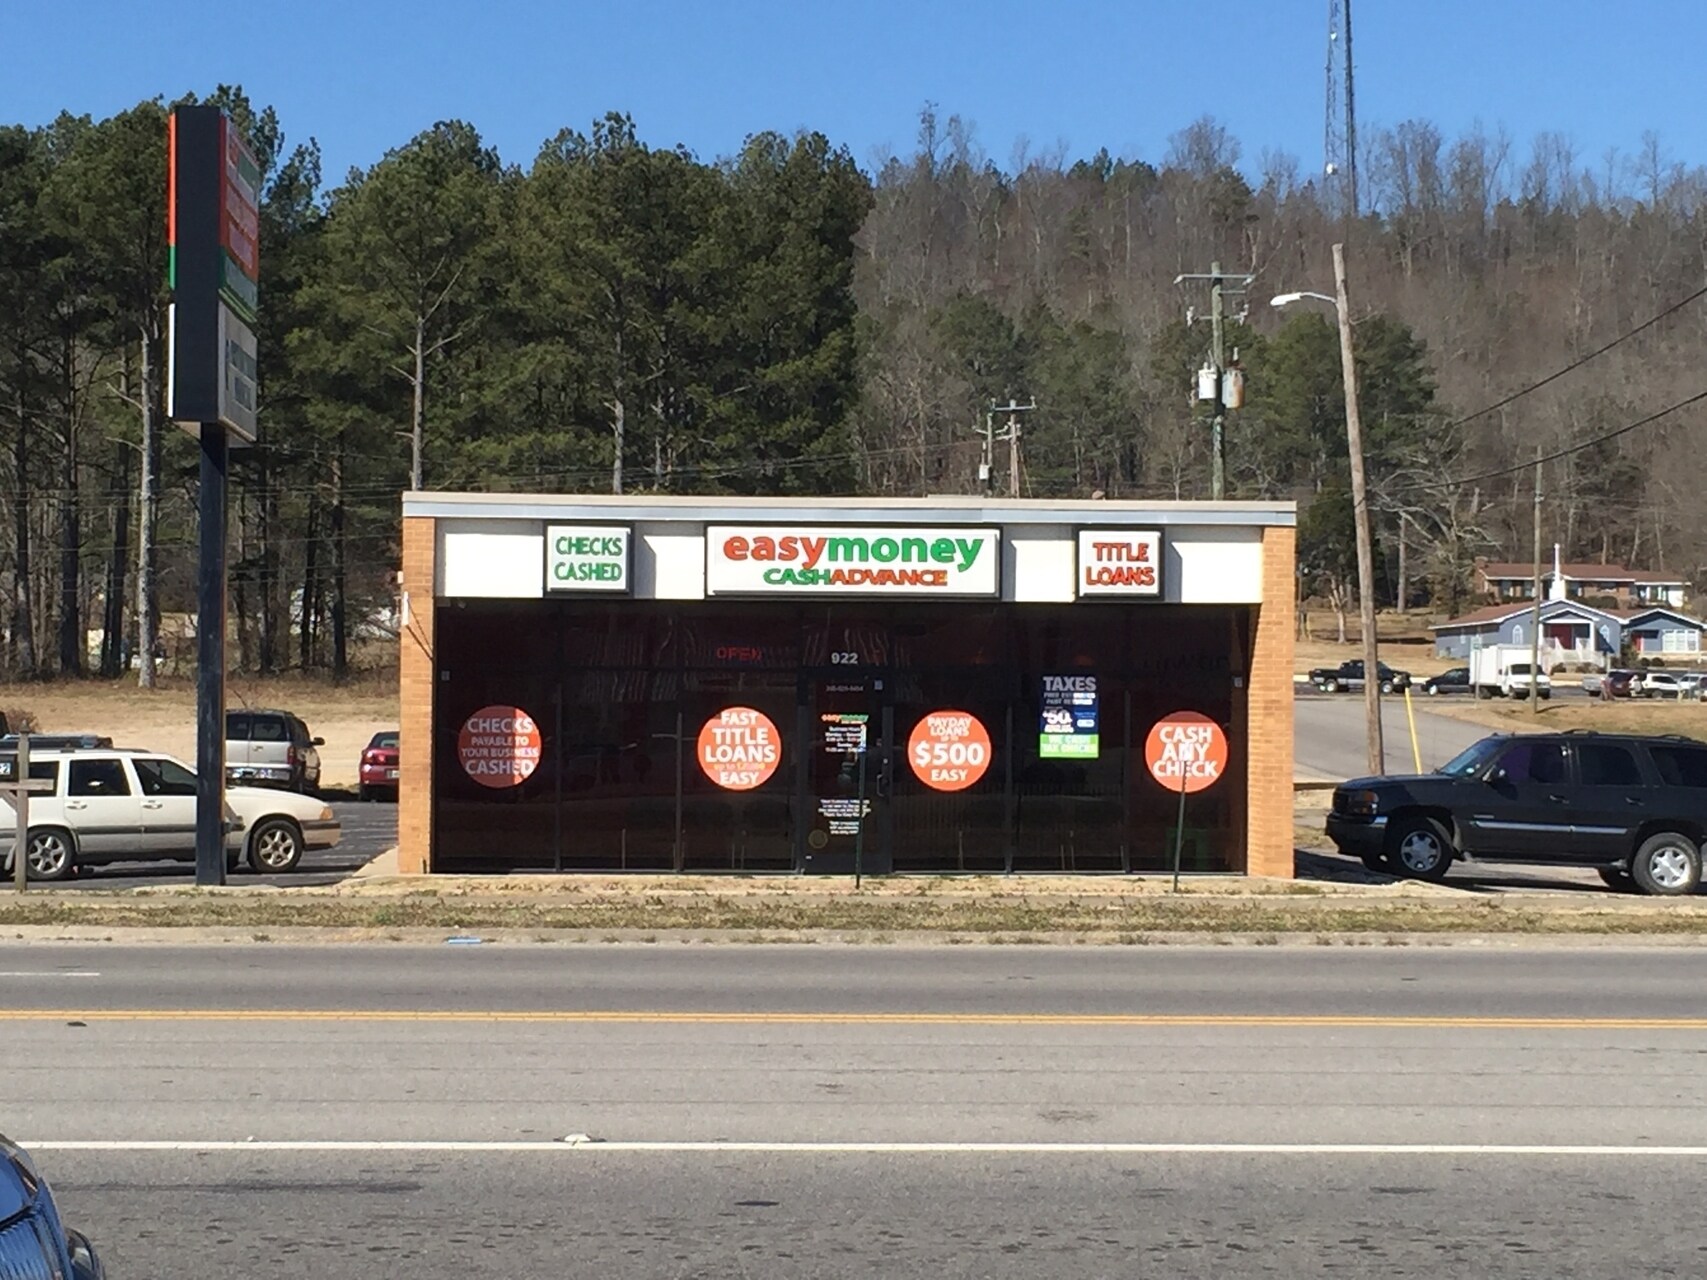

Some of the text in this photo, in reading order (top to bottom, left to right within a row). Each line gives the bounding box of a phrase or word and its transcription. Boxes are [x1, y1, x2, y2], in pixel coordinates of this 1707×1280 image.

[555, 536, 623, 556] CHECKS
[1092, 542, 1149, 562] TITLE
[723, 536, 985, 573] easymoney
[554, 561, 623, 581] CASHED
[1086, 566, 1155, 586] LOANS
[716, 647, 763, 661] OPEN
[831, 652, 858, 664] 922
[1042, 676, 1097, 692] TAXES
[467, 718, 534, 733] CHECKS
[721, 711, 759, 725] FAST
[927, 717, 972, 727] PAYDAY
[712, 727, 769, 745] TITLE
[930, 727, 970, 737] LOANS
[1159, 726, 1213, 743] CASH
[471, 736, 530, 746] PAYABLE TO
[462, 748, 489, 757] YOUR
[704, 744, 777, 763] LOANS
[915, 740, 985, 767] $500
[1161, 742, 1211, 761] ANY
[465, 759, 535, 779] CASHED
[931, 769, 967, 781] EASY
[1153, 761, 1218, 777] CHECK
[720, 771, 759, 784] EASY
